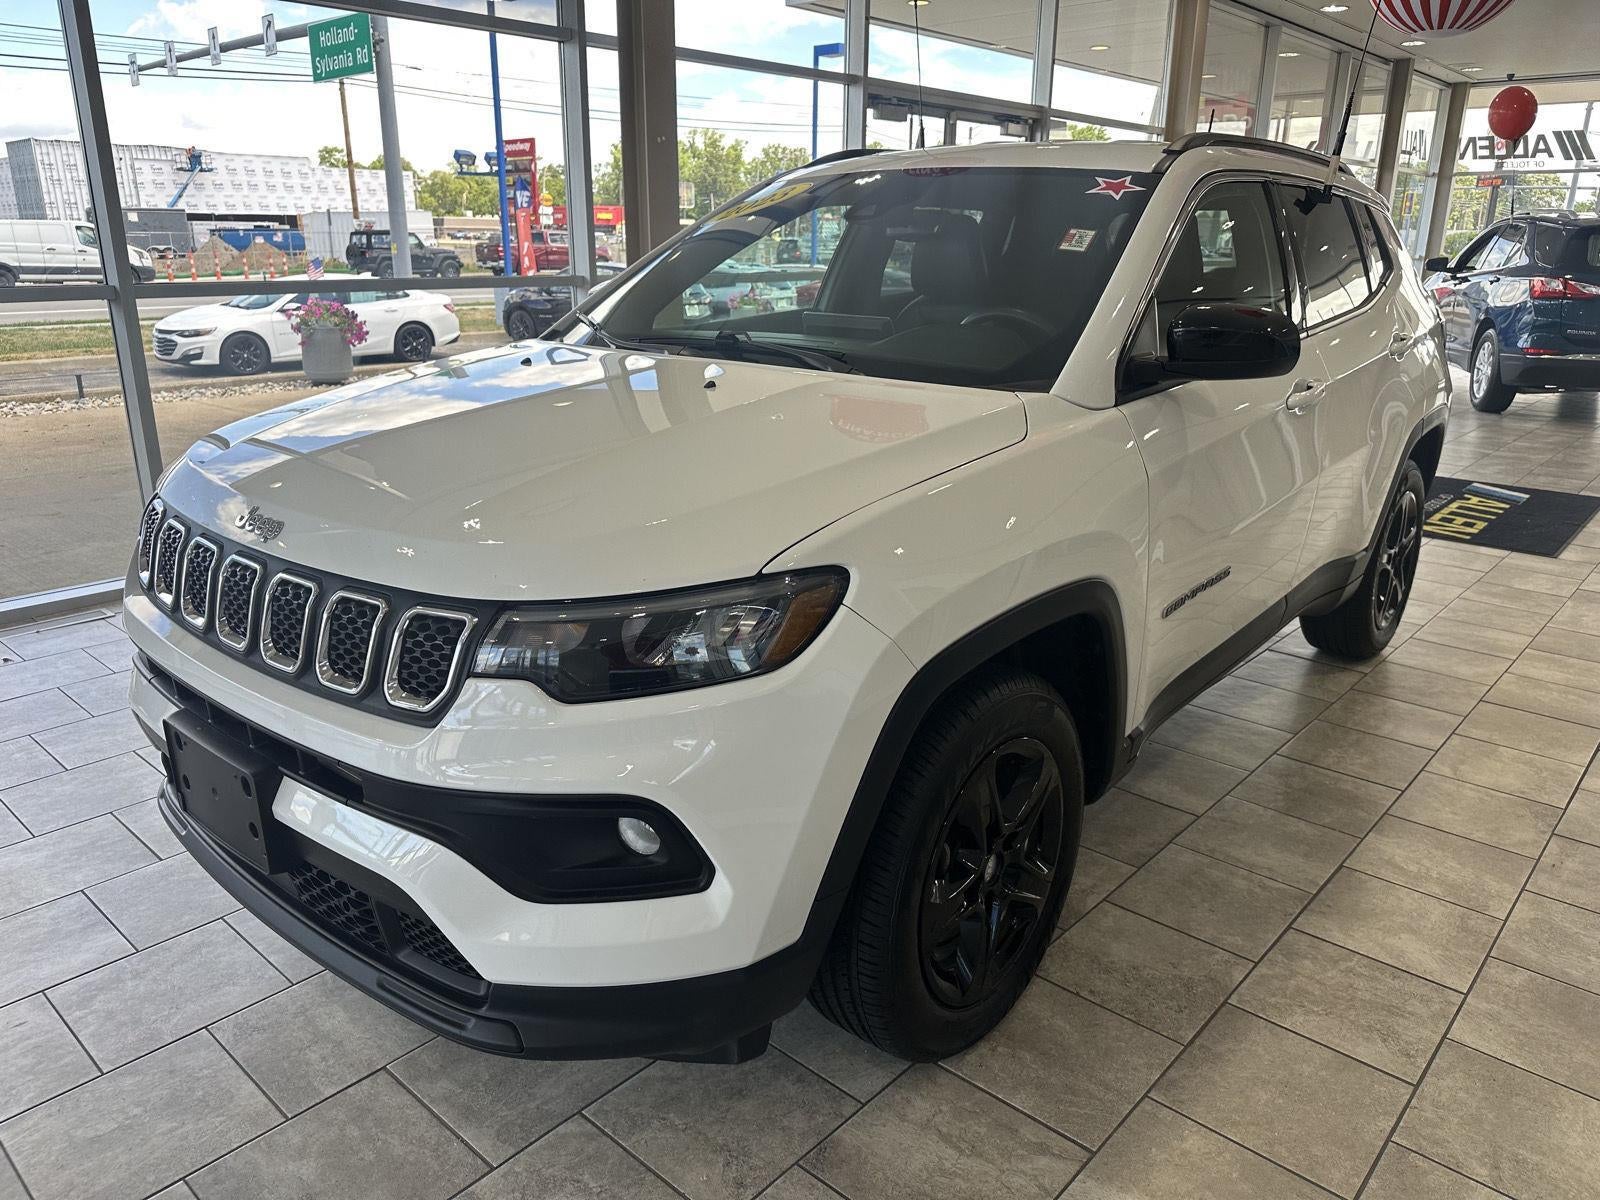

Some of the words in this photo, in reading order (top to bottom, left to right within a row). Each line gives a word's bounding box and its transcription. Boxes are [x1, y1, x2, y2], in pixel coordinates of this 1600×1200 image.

[319, 22, 358, 47] Holland-
[315, 50, 353, 77] Sylvania
[356, 44, 369, 65] Rd
[234, 505, 285, 544] Jeep
[1422, 493, 1511, 539] ALLEN
[1161, 565, 1232, 619] COMPASS
